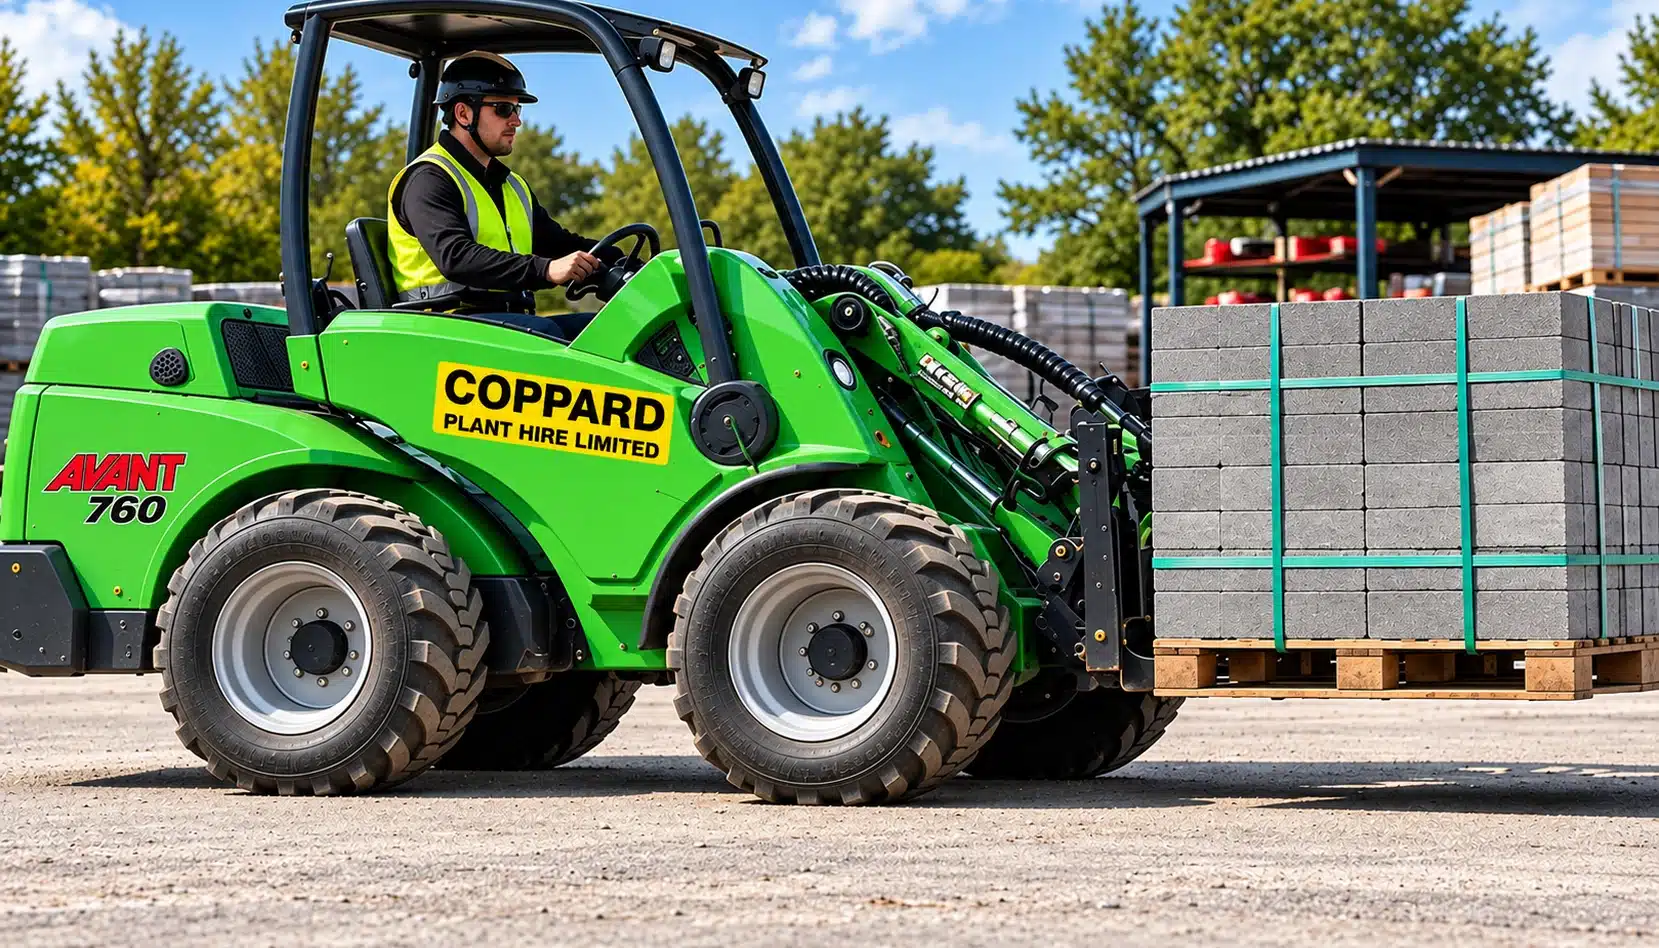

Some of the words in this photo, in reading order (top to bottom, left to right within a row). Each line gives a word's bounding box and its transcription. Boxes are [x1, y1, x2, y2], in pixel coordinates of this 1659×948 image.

[444, 369, 665, 432] COPPARD
[443, 413, 513, 438] PLANT
[518, 424, 568, 446] HIRE
[575, 432, 660, 459] LIMITED
[43, 453, 187, 492] AVANT
[85, 495, 167, 524] 760
